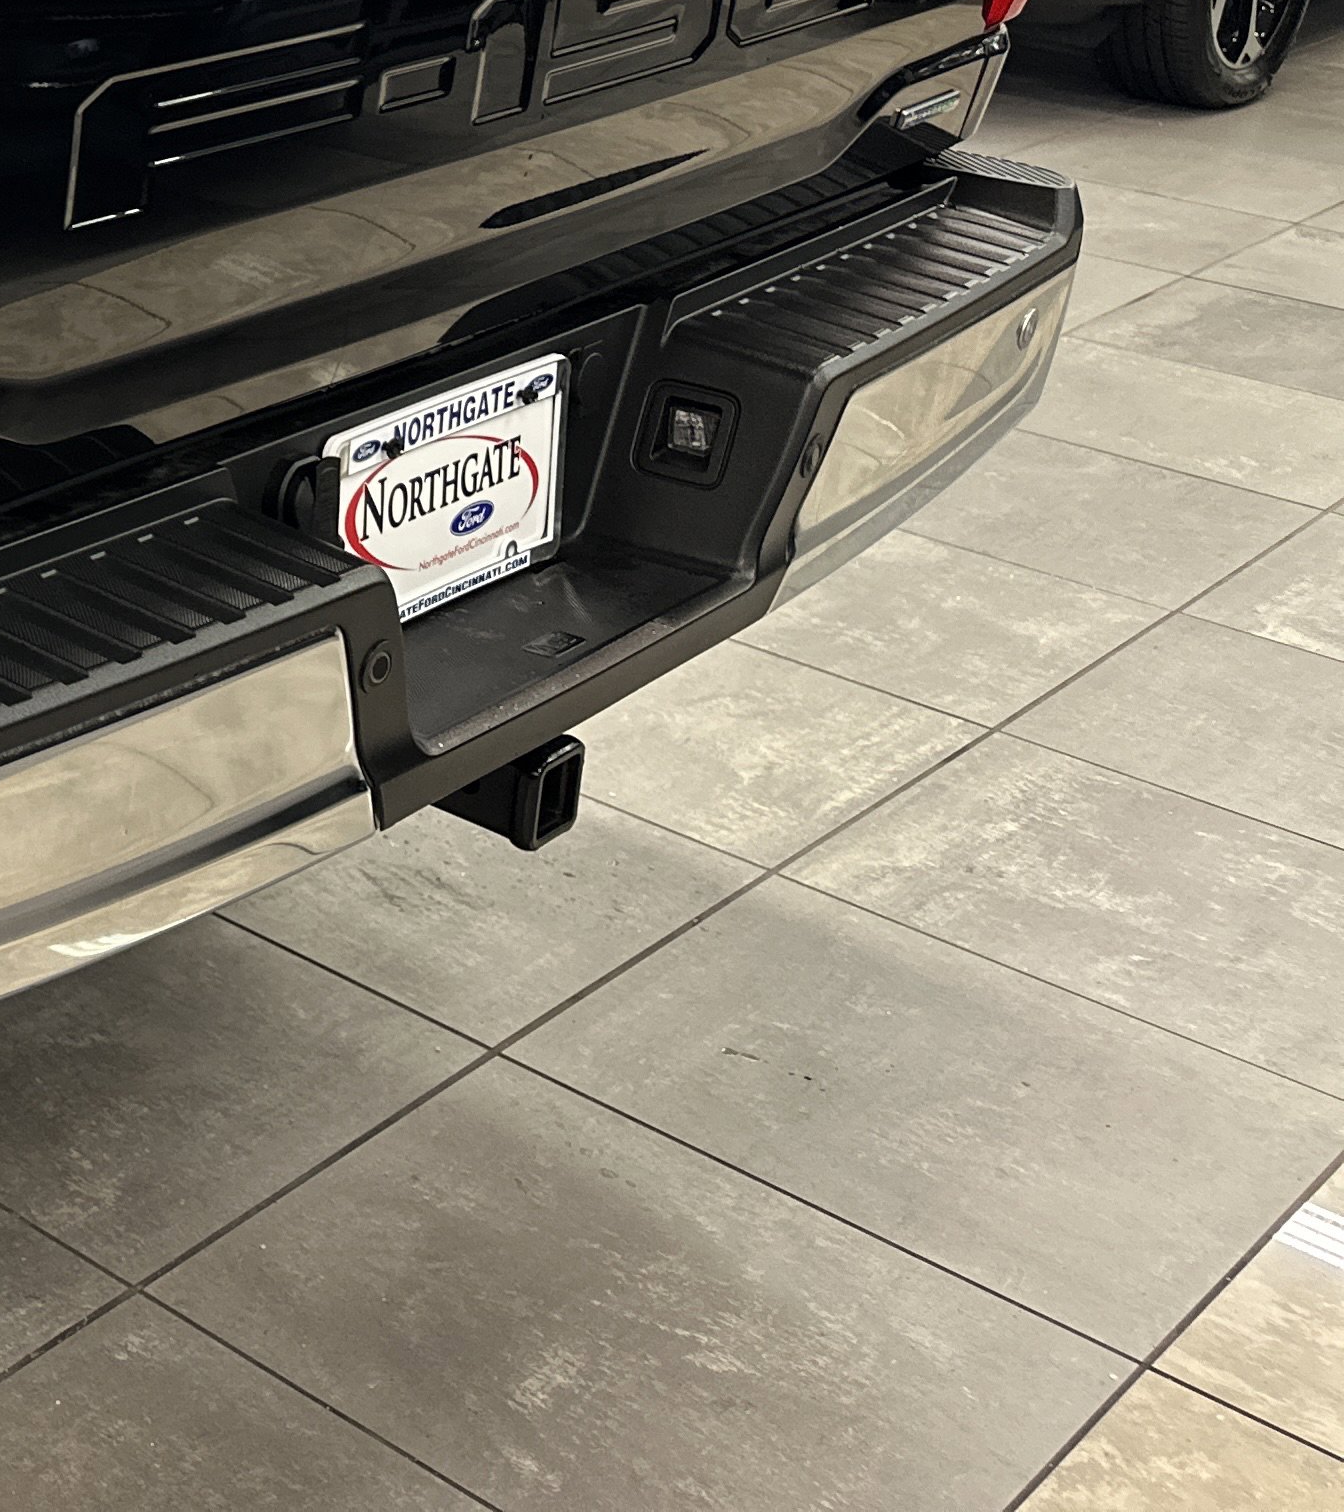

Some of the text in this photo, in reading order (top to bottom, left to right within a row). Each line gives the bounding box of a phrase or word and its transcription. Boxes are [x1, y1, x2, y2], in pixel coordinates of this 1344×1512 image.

[393, 380, 515, 451] NORTHGATE
[359, 435, 522, 541] NORTHGATE
[458, 505, 487, 531] Ford
